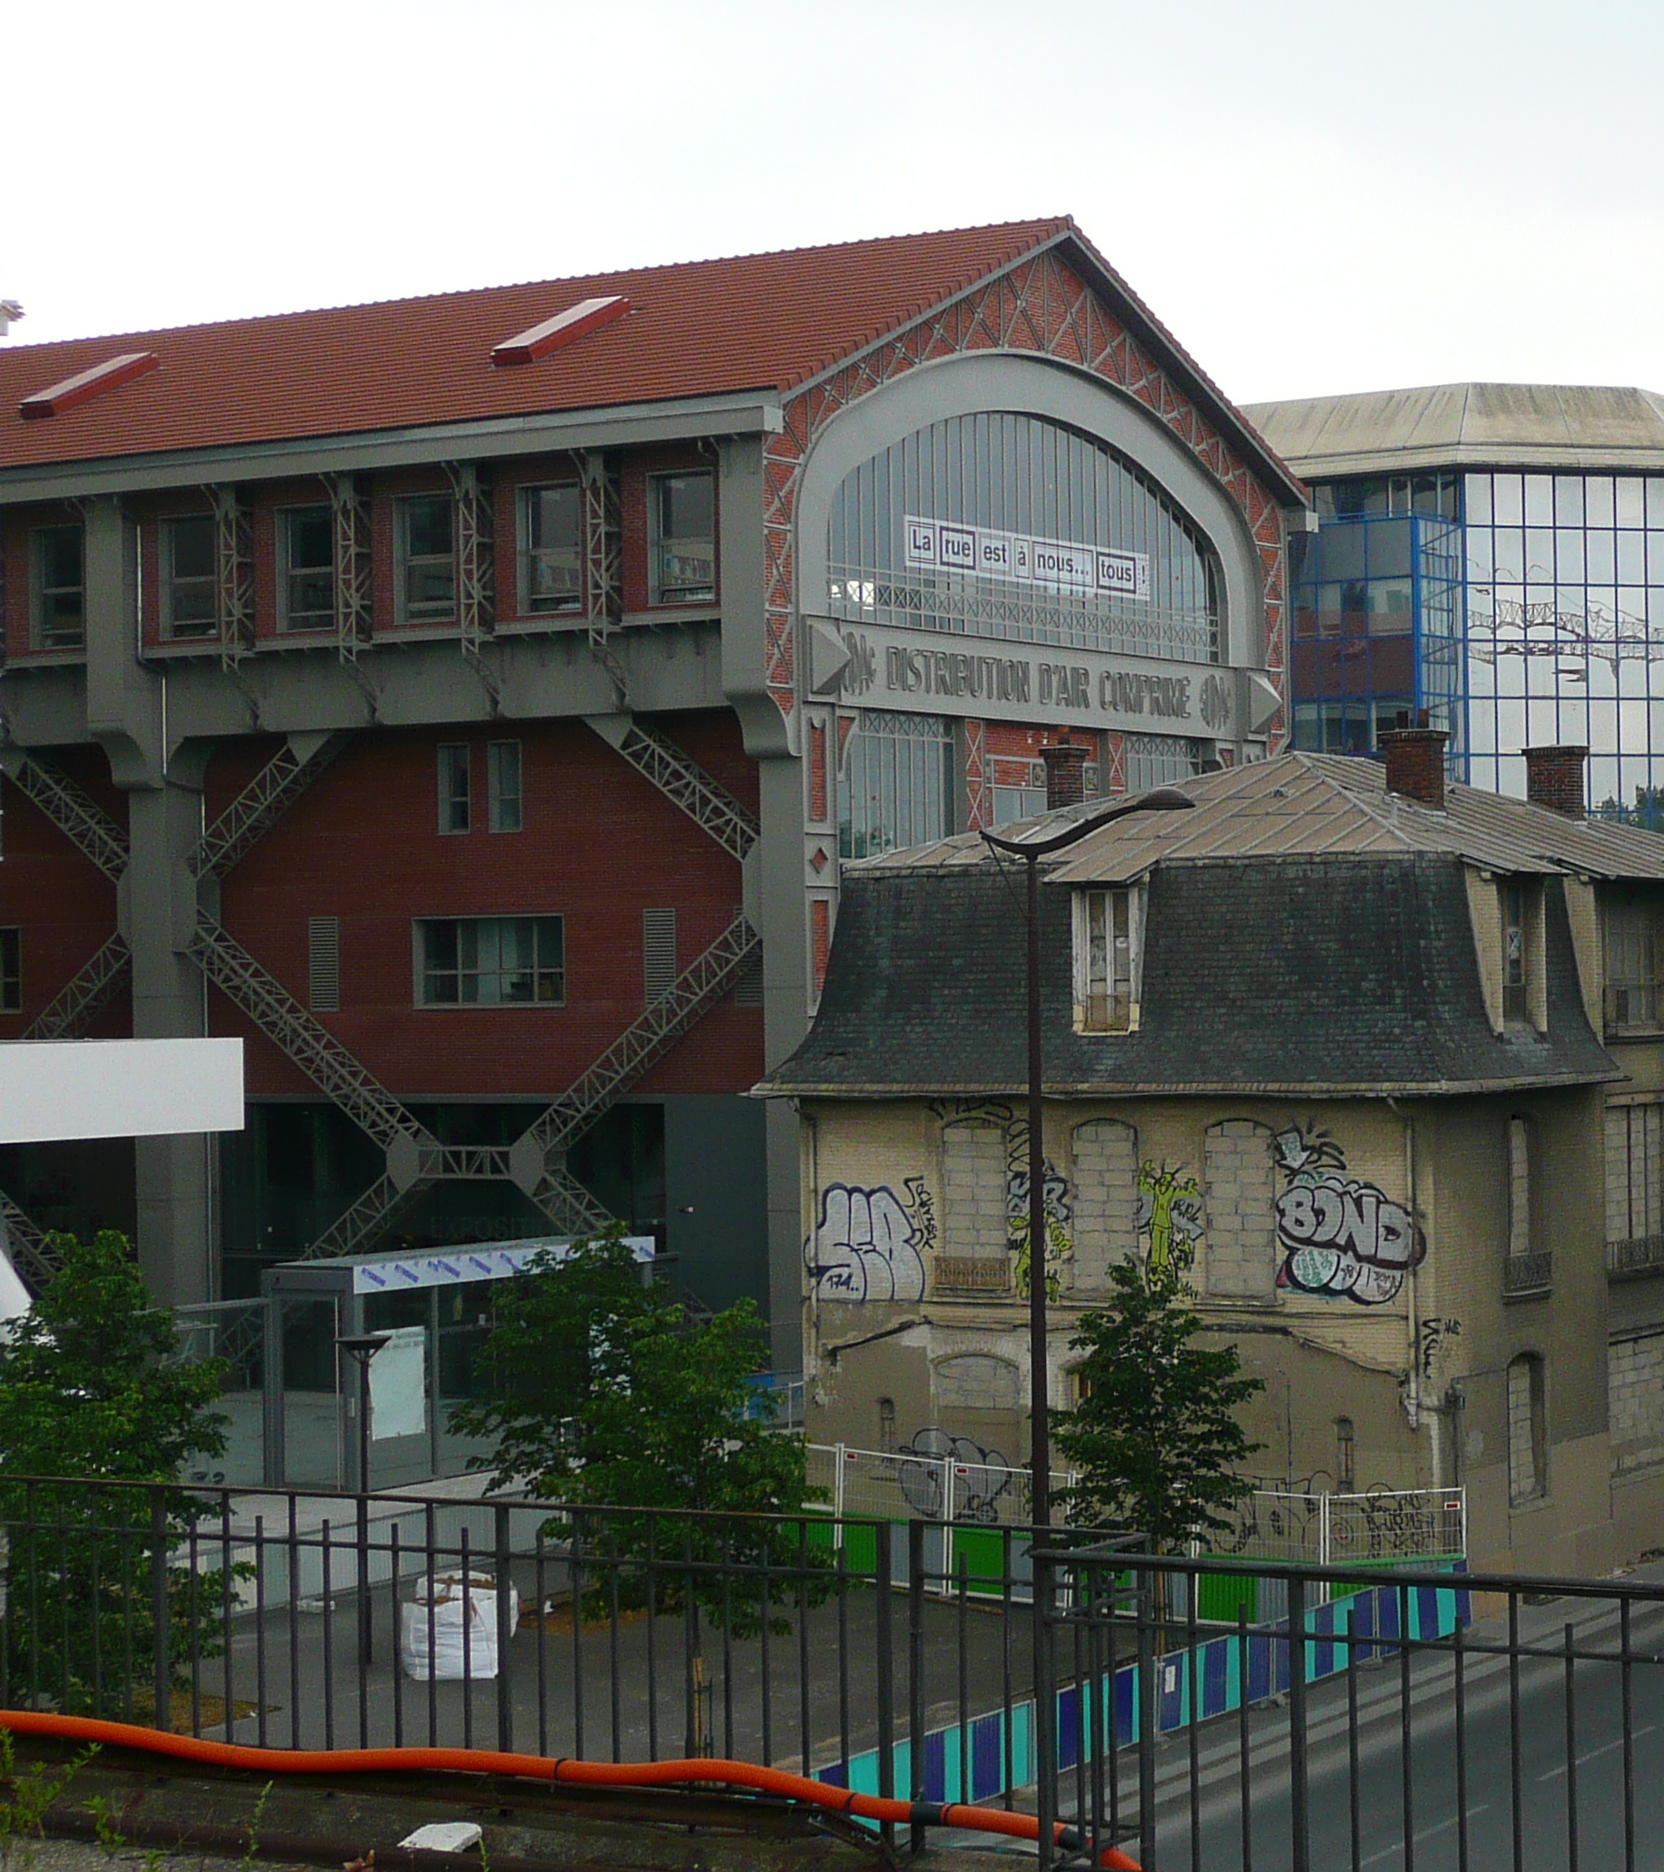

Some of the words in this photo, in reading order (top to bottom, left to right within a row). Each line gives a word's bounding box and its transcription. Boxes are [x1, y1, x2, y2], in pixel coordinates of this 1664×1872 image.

[912, 528, 931, 551] La
[944, 538, 971, 558] rue
[983, 542, 1008, 564] est
[1017, 545, 1026, 567] à
[1036, 552, 1090, 577] nous...
[1100, 560, 1132, 583] tous
[886, 645, 1031, 703] DISTRIBUTION
[1038, 661, 1091, 710] D'AIR
[1275, 1184, 1427, 1270] BOND
